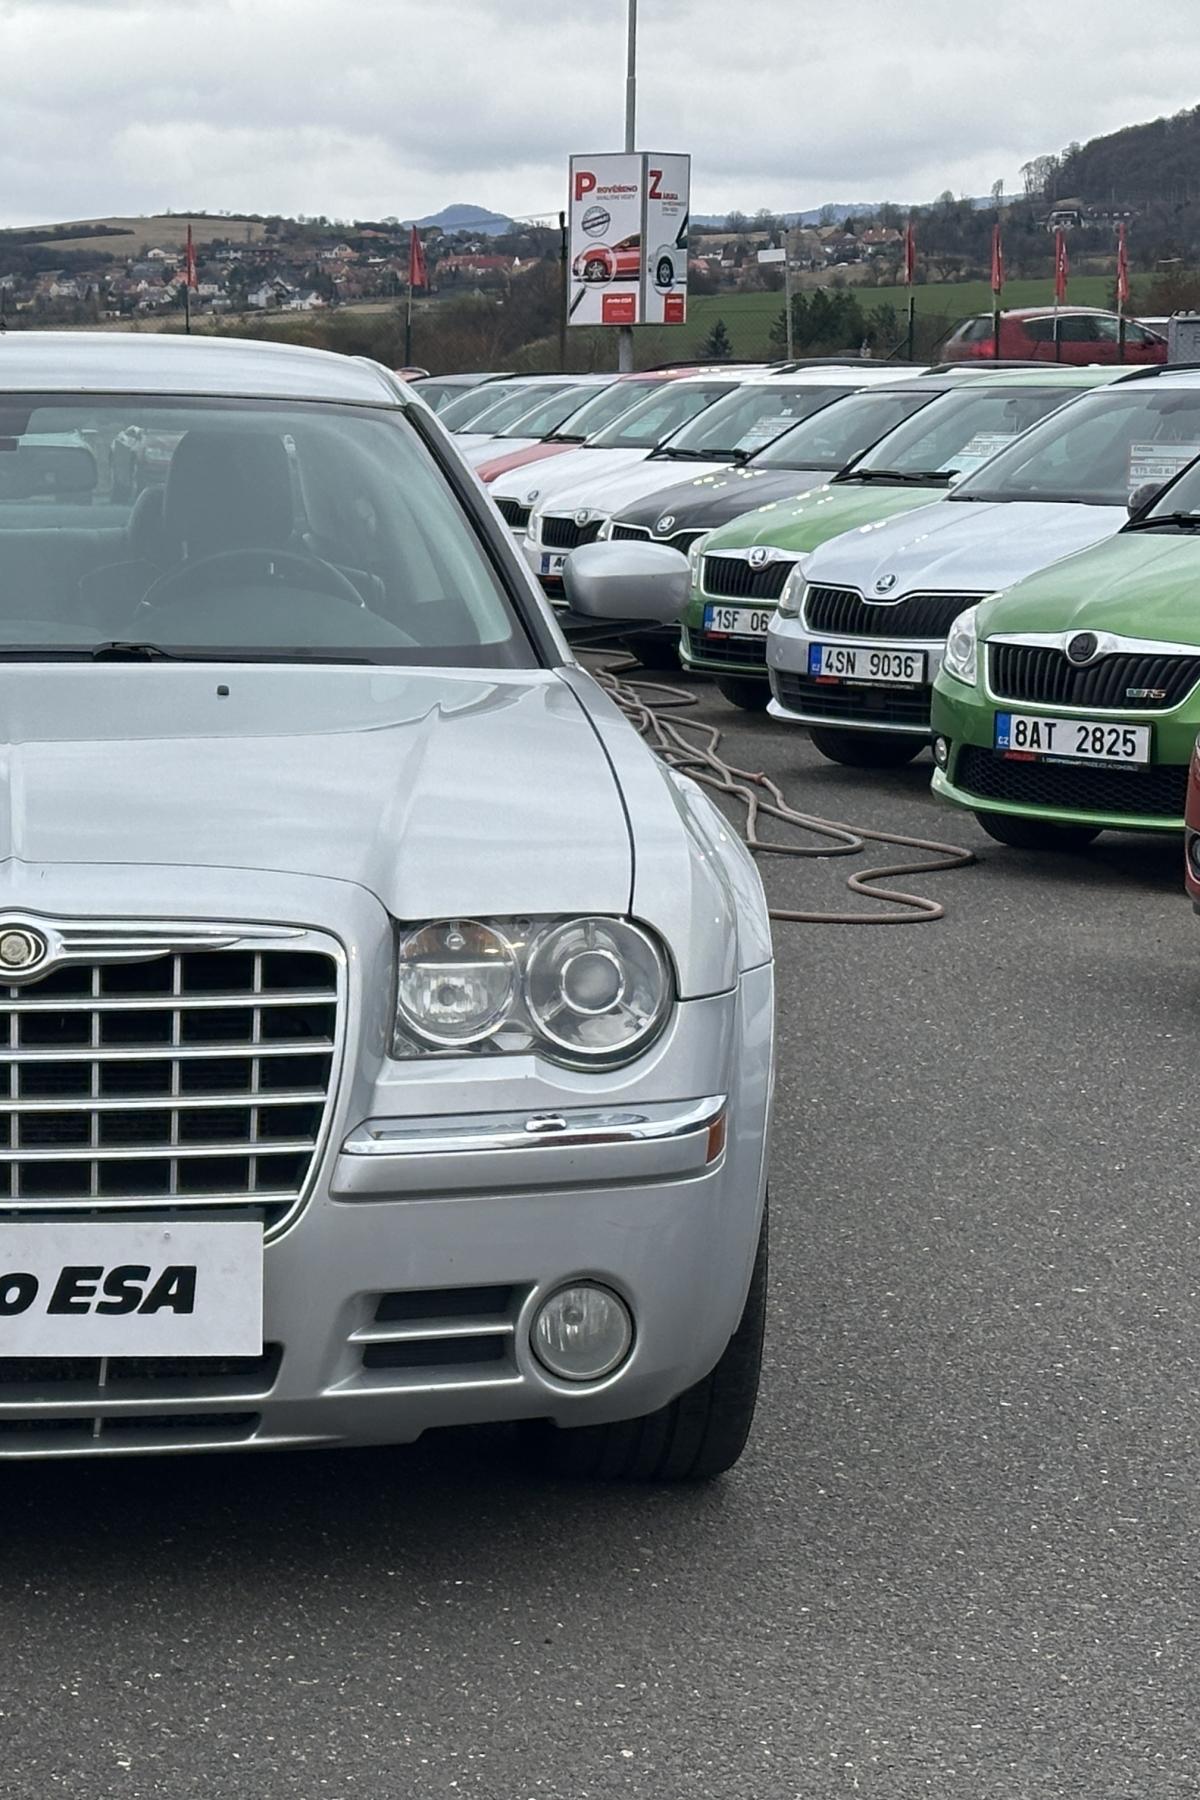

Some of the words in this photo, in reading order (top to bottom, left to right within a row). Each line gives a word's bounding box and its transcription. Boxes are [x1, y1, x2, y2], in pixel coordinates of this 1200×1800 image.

[716, 610, 740, 630] 1SF
[825, 650, 856, 675] 4SN
[869, 653, 915, 679] 9036
[1015, 720, 1057, 750] 8AT
[1076, 725, 1137, 757] 2825
[46, 1264, 197, 1315] ESA
